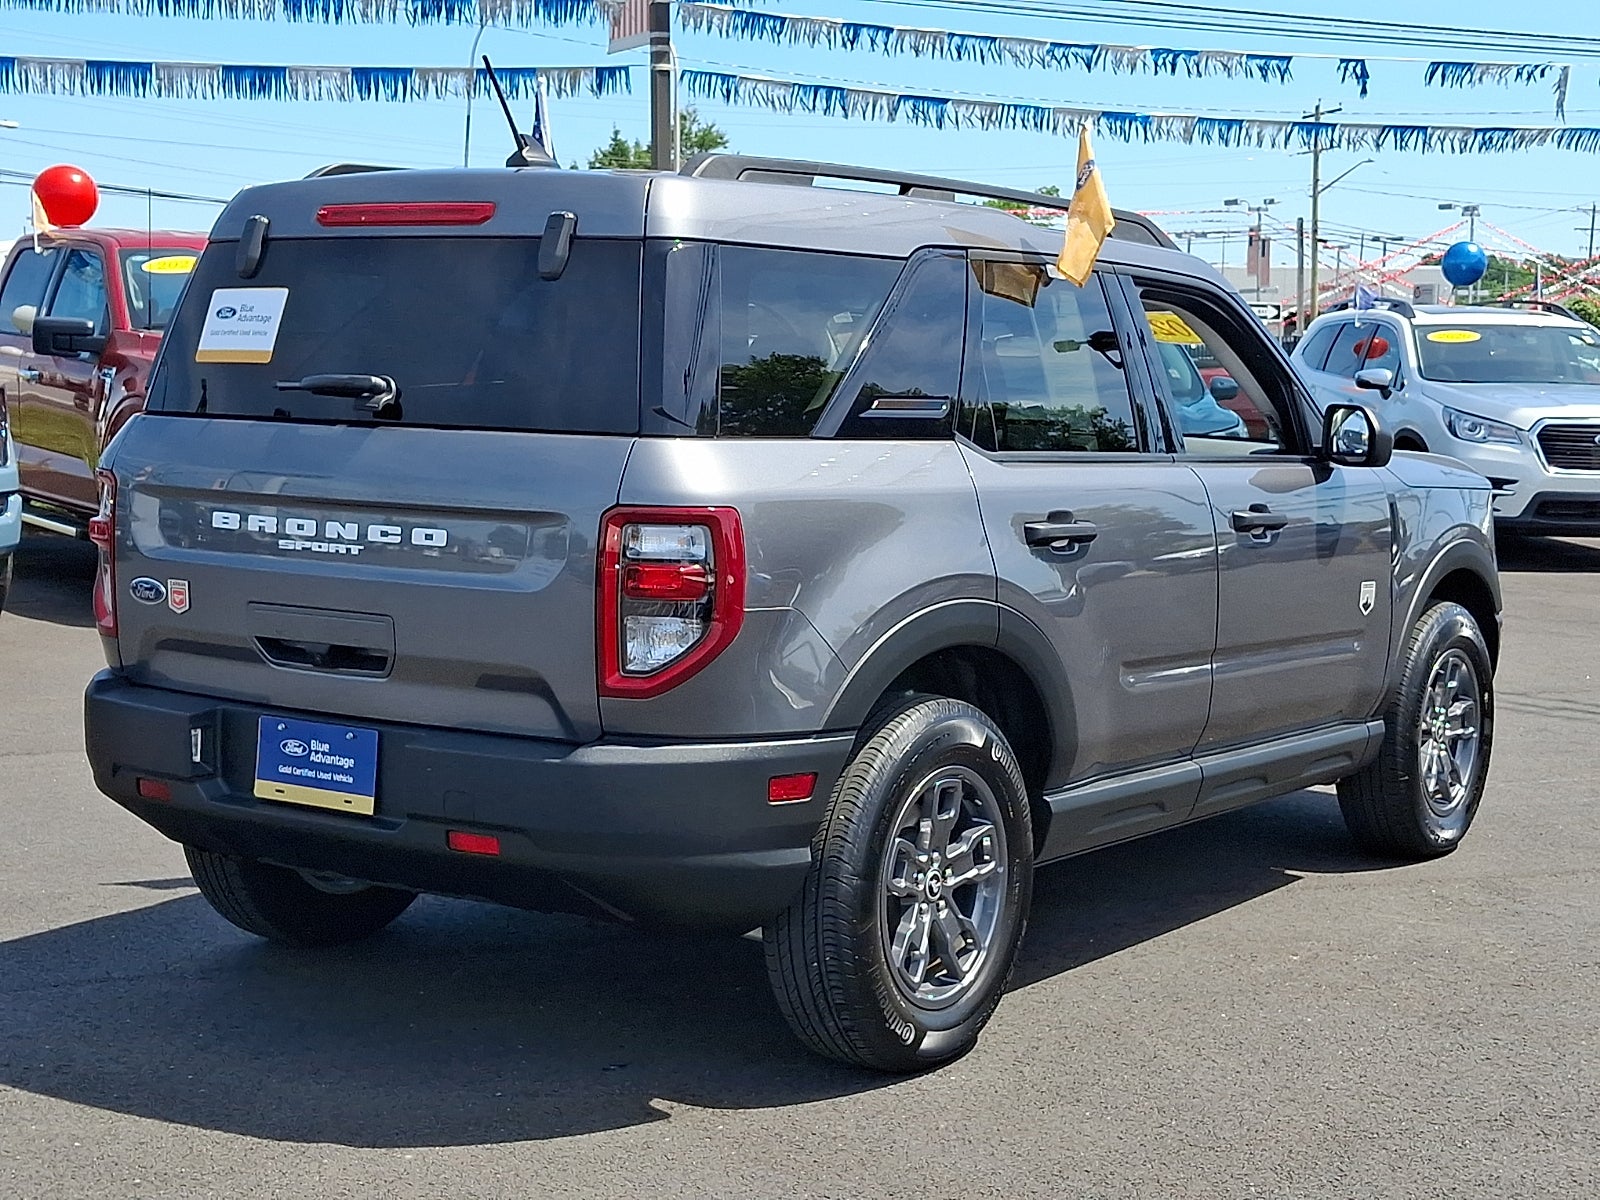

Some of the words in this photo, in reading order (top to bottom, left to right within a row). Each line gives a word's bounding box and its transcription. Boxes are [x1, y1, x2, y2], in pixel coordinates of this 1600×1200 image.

[240, 304, 254, 313] Blue
[237, 315, 272, 324] Advantage
[212, 511, 448, 547] BRONCO
[278, 539, 364, 556] SPORT
[310, 740, 330, 752] Blue
[310, 752, 355, 769] Advantage
[278, 764, 292, 774] Gold
[293, 767, 315, 778] Certified
[316, 770, 332, 780] Used
[333, 773, 354, 784] Vehicle
